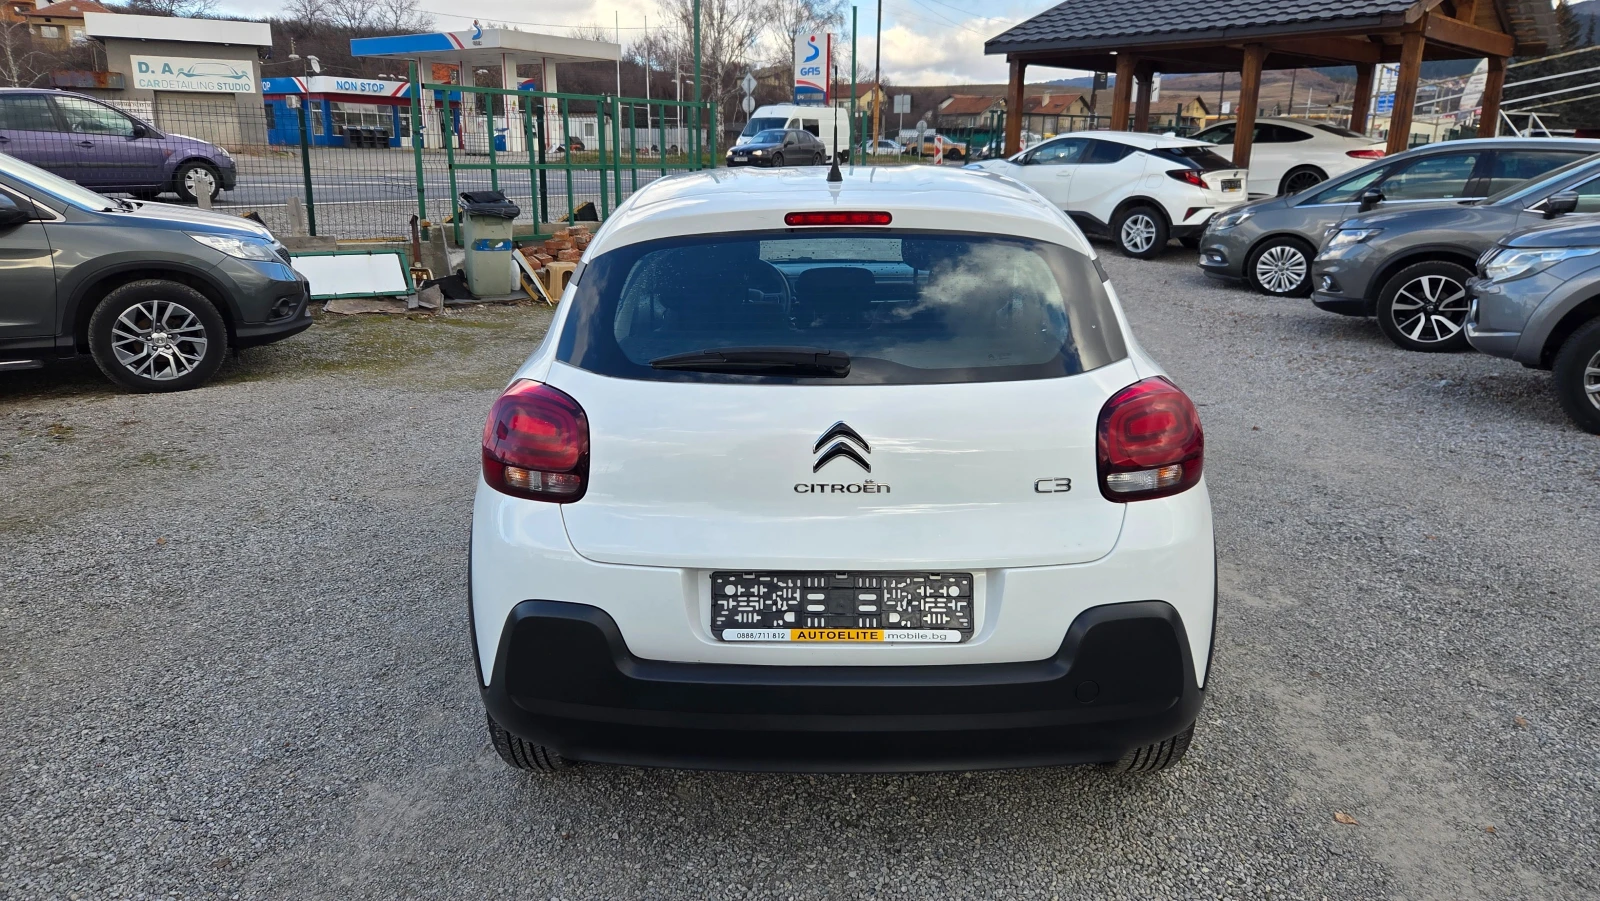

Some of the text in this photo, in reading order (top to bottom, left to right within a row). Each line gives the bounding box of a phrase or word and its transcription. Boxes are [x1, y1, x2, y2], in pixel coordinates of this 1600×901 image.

[800, 66, 821, 76] GAS
[217, 82, 251, 92] STUDIO
[336, 80, 385, 93] NON STOP
[1033, 477, 1072, 494] C3
[772, 631, 786, 640] 812
[797, 630, 879, 641] AUTOELITE
